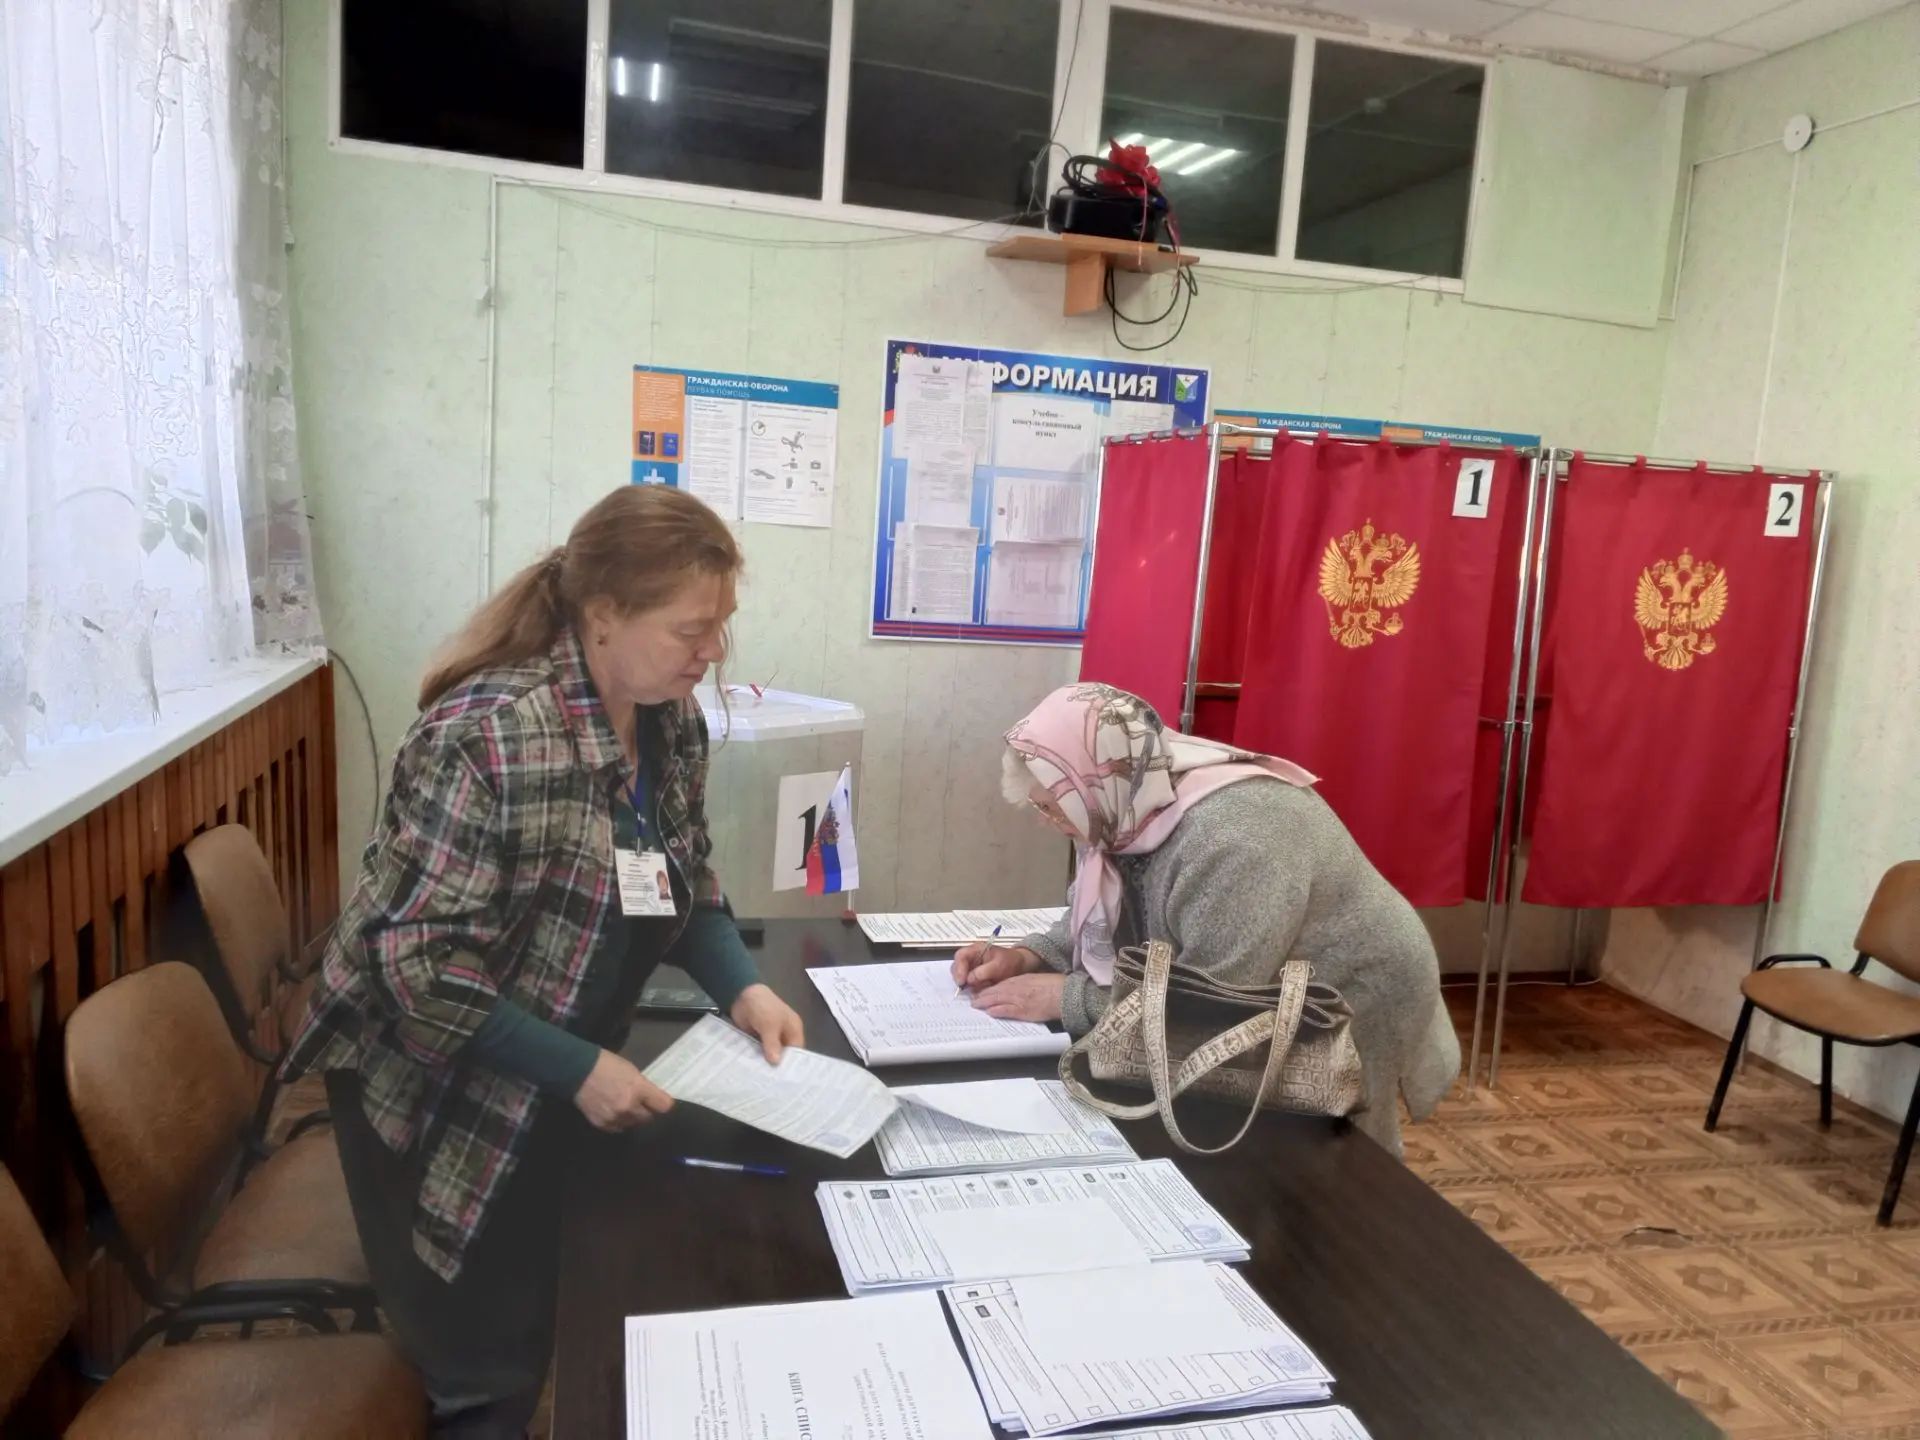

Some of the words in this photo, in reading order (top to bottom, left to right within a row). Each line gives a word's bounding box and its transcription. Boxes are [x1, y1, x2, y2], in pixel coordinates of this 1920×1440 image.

[687, 376, 748, 389] ГРАЖДАНСКАЯ
[751, 382, 789, 392] ОБОРОНА
[943, 356, 1158, 398] ФОРМАЦИЯ
[1466, 468, 1484, 506] 1
[1773, 491, 1794, 526] 2
[795, 803, 817, 871] 1
[787, 1372, 804, 1404] КНИГА
